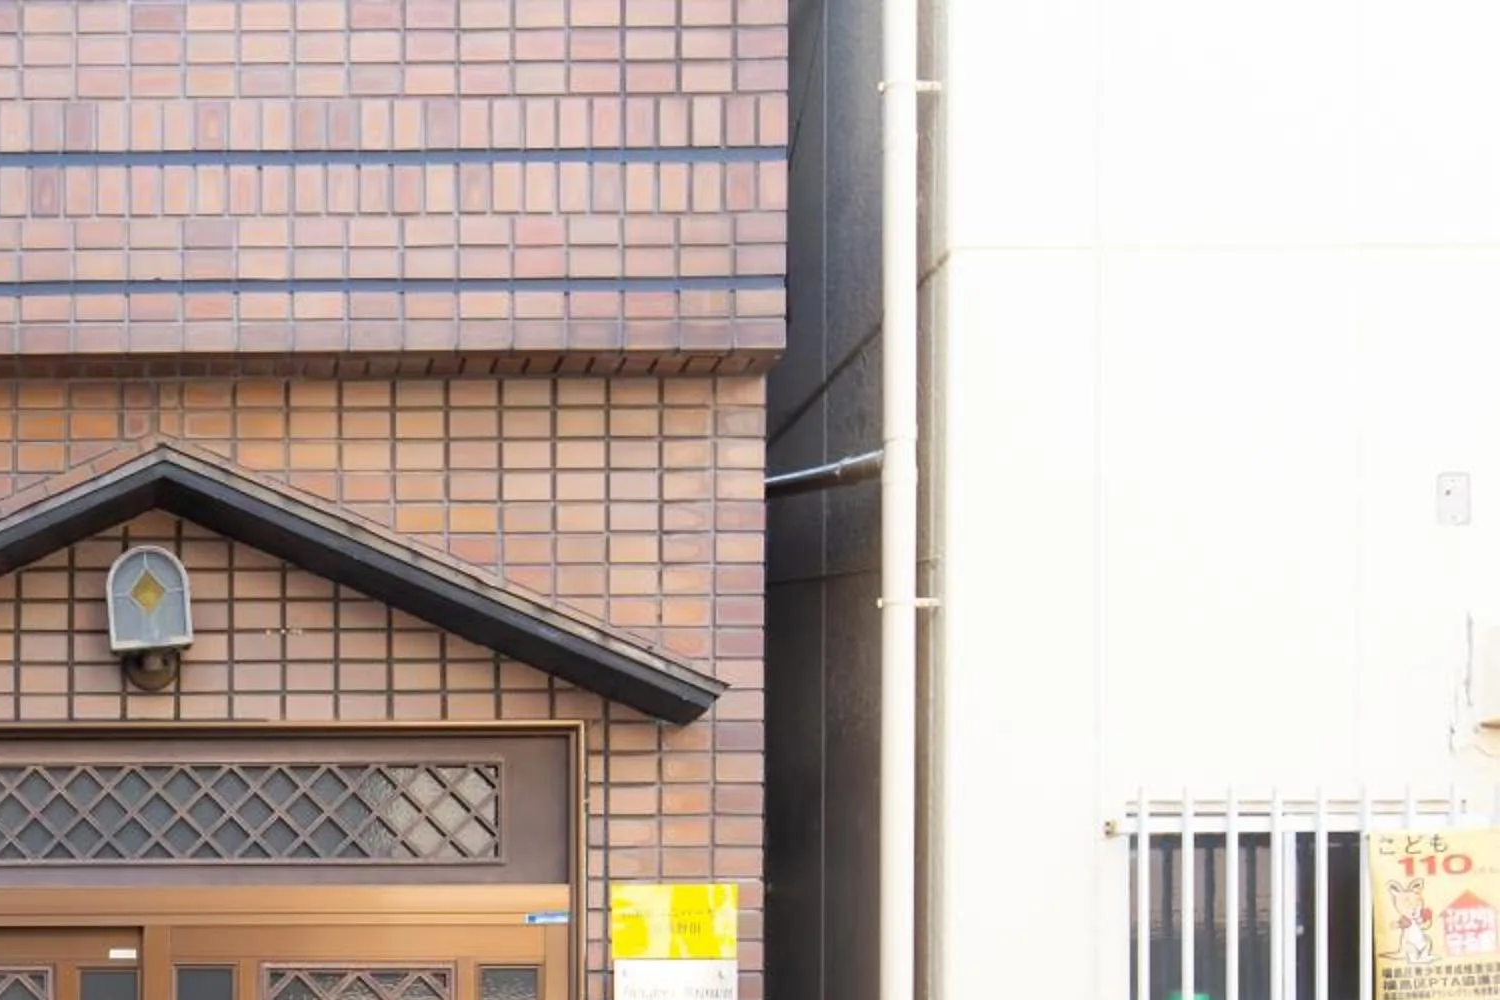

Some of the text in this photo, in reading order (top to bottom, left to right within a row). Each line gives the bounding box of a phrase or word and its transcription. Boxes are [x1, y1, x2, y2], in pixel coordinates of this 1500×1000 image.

[1379, 834, 1448, 856] こども
[1398, 854, 1473, 877] 110
